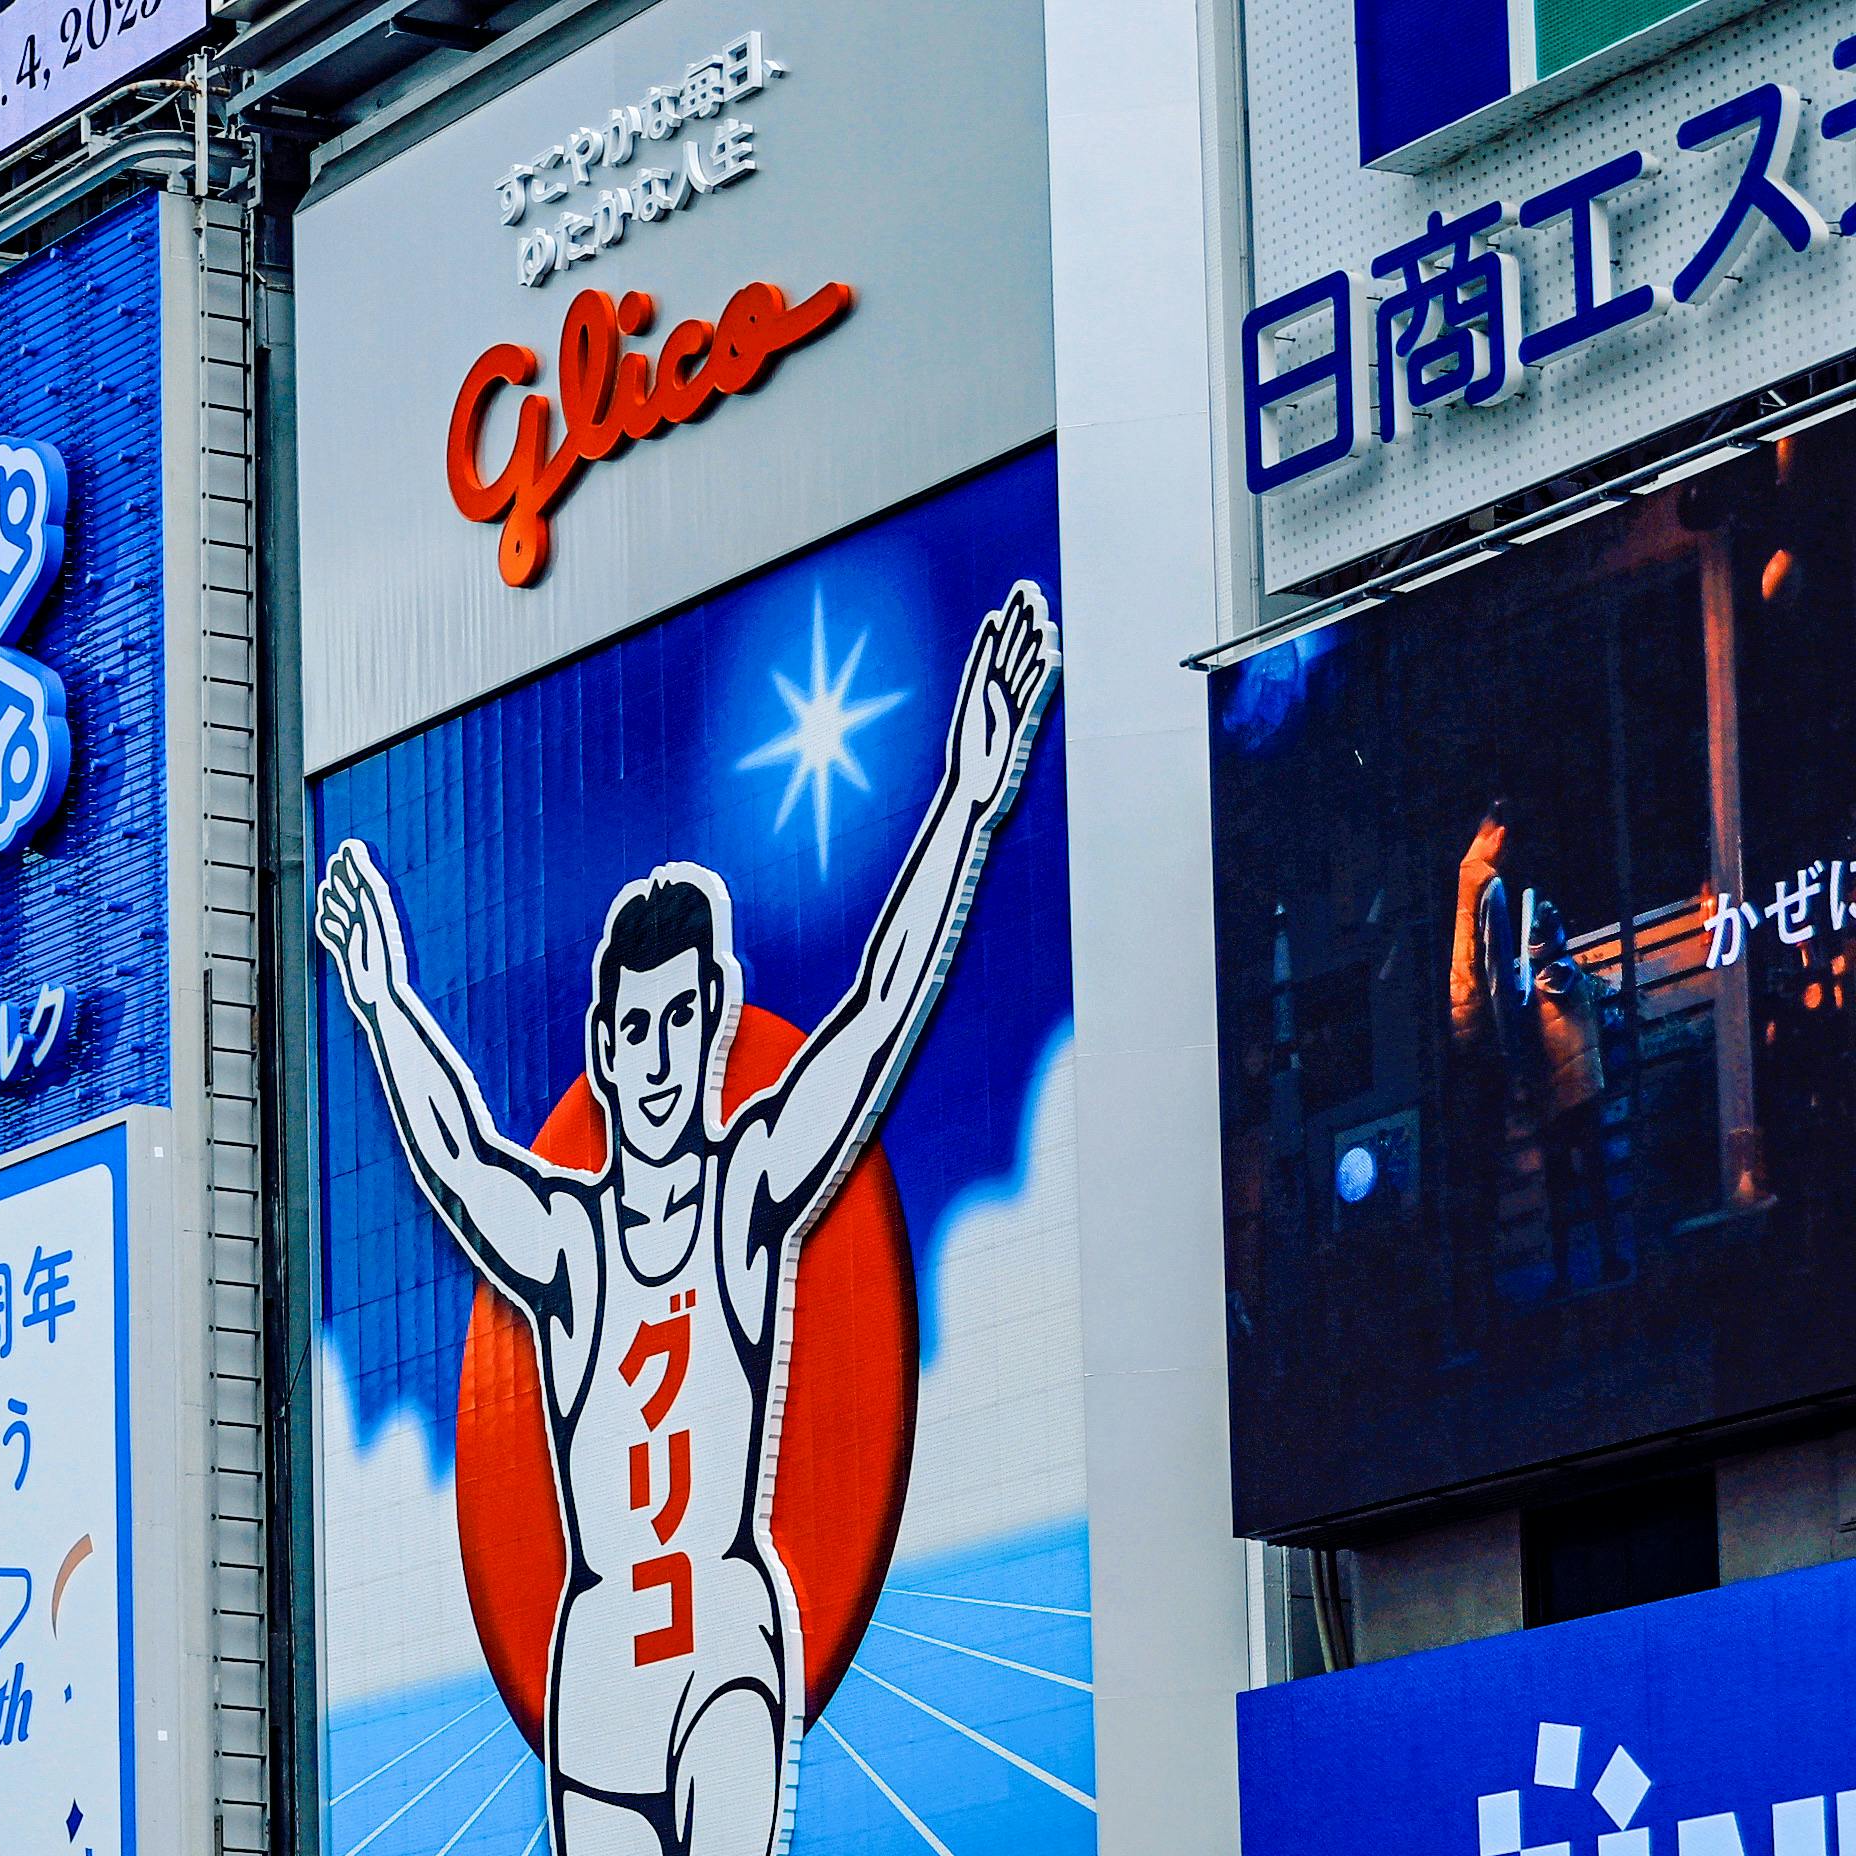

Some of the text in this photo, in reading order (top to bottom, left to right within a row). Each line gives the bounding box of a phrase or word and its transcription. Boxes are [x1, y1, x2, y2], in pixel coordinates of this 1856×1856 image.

[16, 34, 51, 92] 4,
[516, 119, 756, 288] ゆたかな人生
[1242, 33, 1856, 495] 日商エス
[446, 281, 851, 588] Glico
[618, 1288, 696, 1668] グリコ
